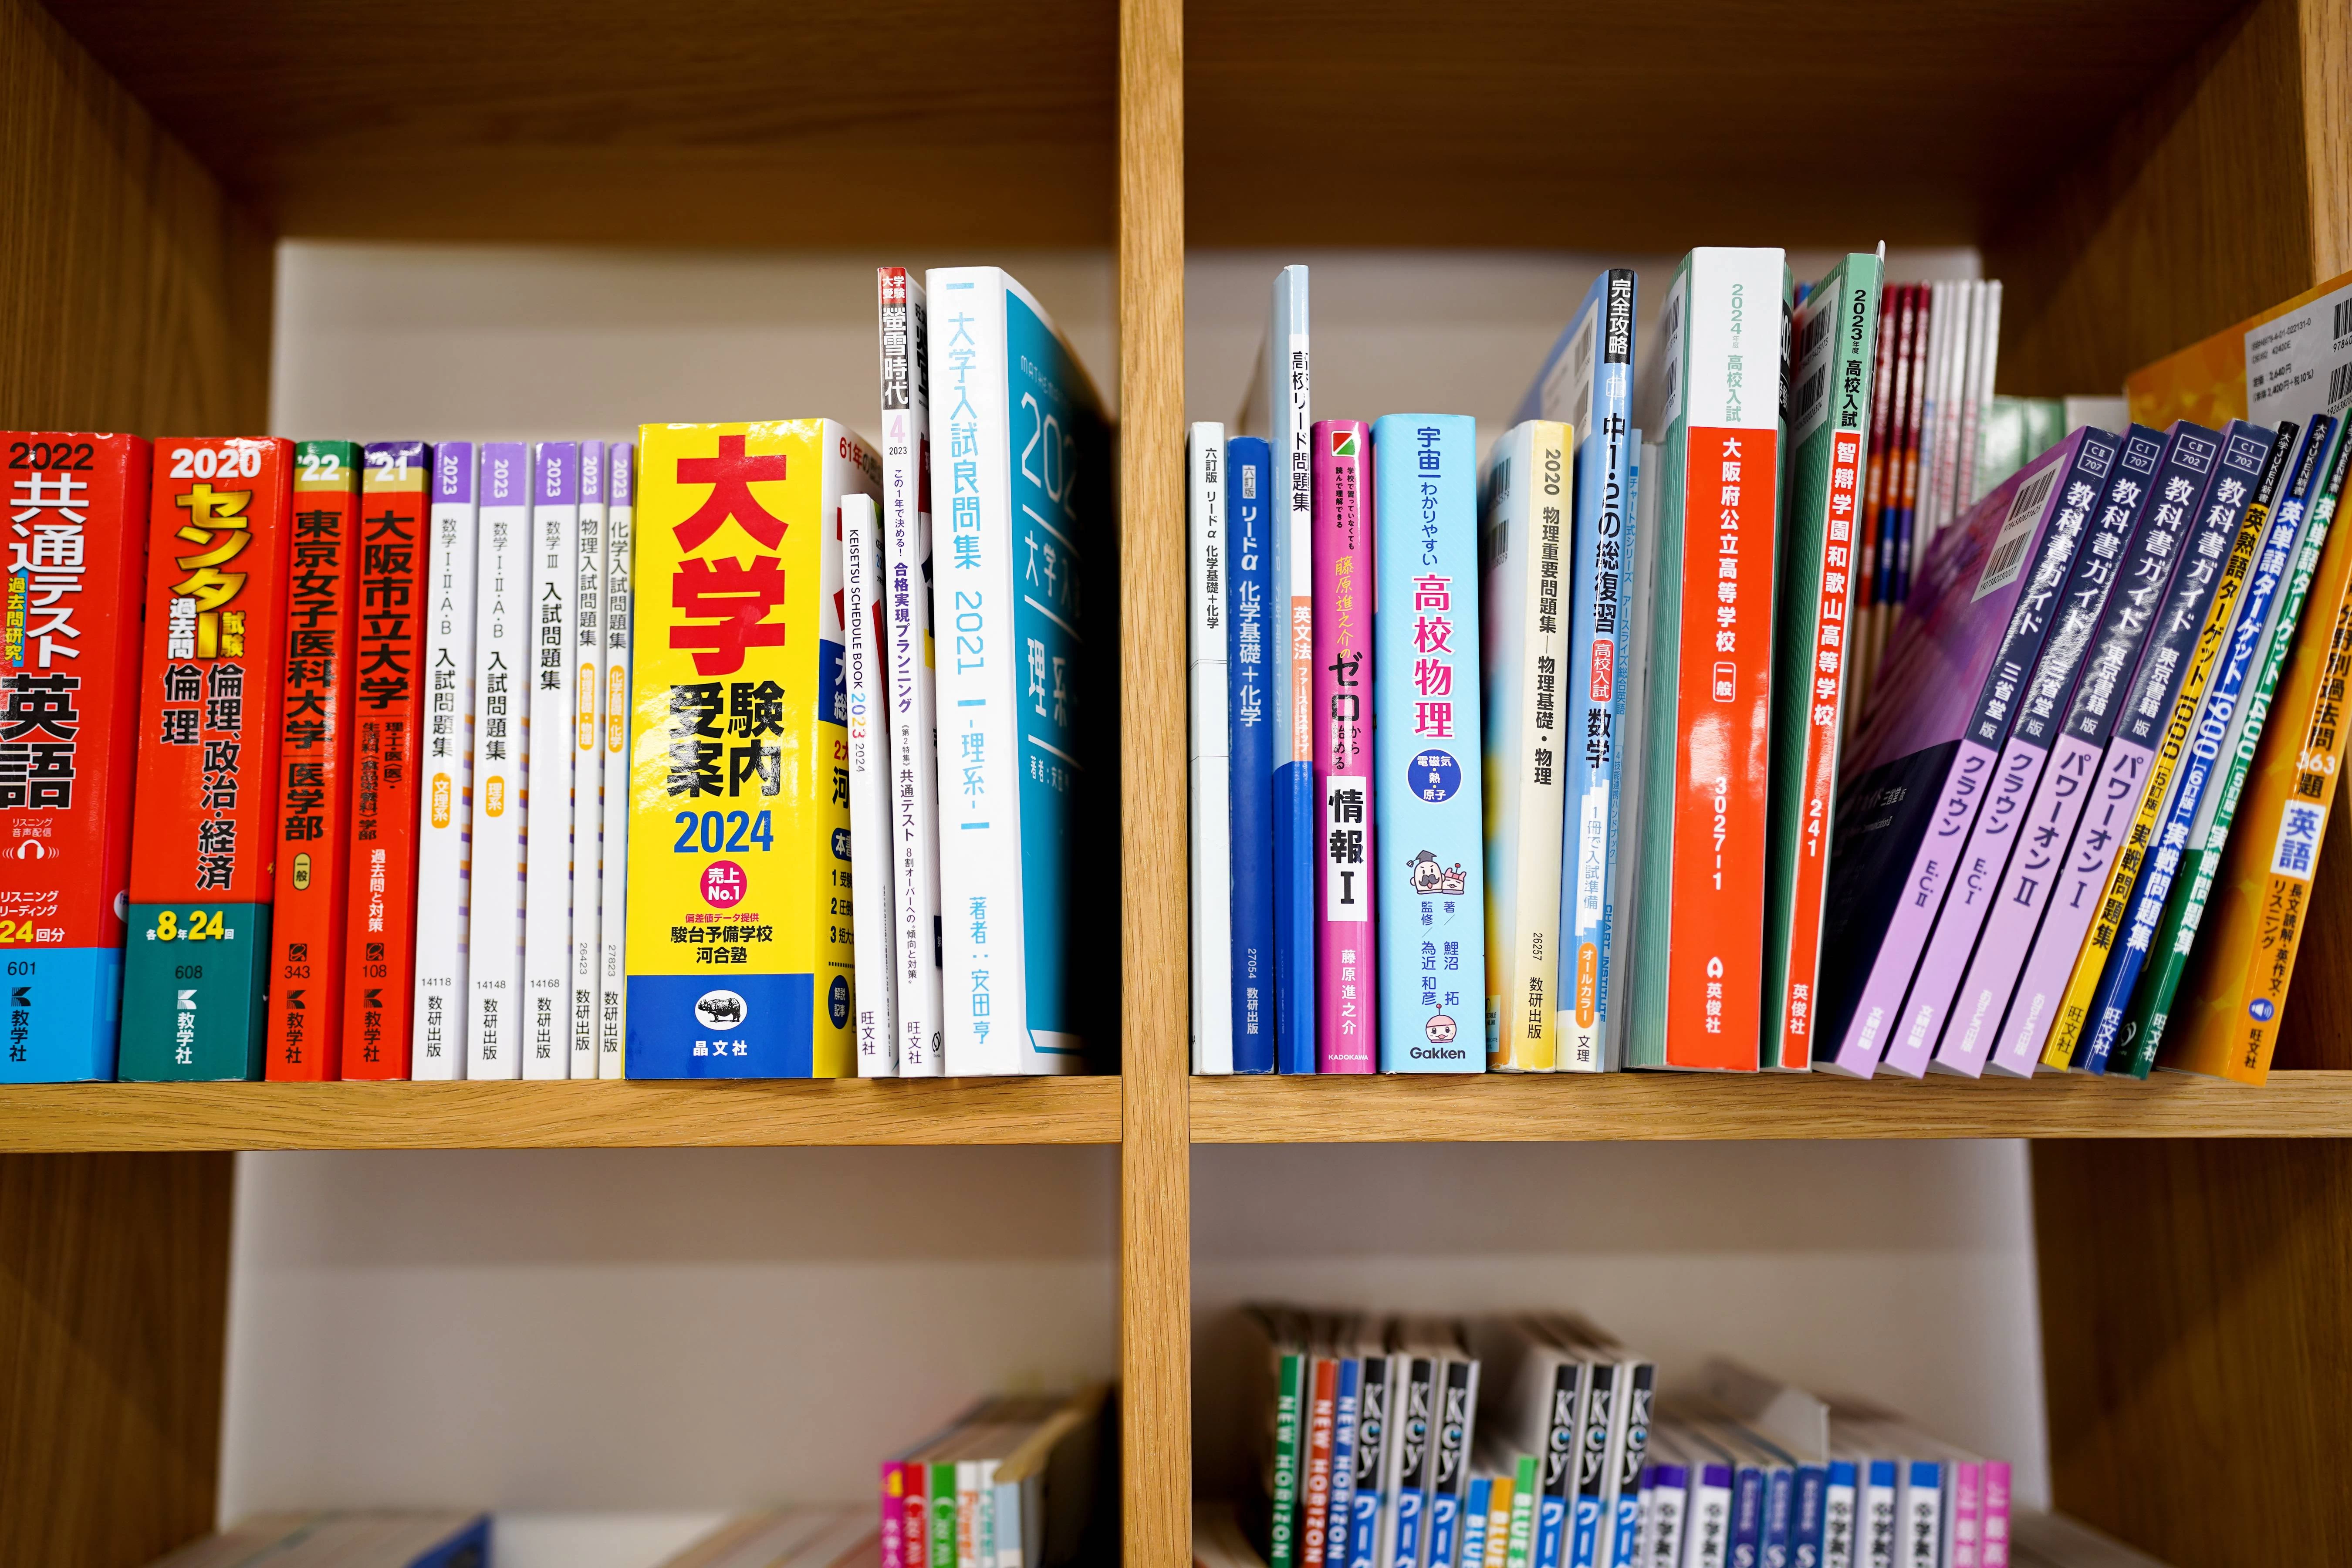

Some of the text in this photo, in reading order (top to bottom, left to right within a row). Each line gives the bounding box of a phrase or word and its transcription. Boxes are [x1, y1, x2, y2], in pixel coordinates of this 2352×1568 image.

[882, 276, 906, 287] 大学
[882, 287, 906, 300] 受験
[1609, 278, 1632, 355] 完全攻略
[1725, 354, 1744, 422] 高校入試
[1841, 359, 1863, 429] 高校入試
[889, 446, 908, 455] 2023
[890, 415, 906, 444] 4
[9, 442, 94, 471] 2022
[170, 449, 261, 479] 2020
[442, 455, 459, 496] 2023
[493, 459, 509, 499] 2023
[546, 457, 562, 498] 2023
[582, 455, 598, 496] 2023
[612, 458, 628, 499] 2023
[1205, 447, 1218, 483] 六訂版
[1243, 466, 1256, 498] 六訂版
[1544, 449, 1561, 496] 2020
[2084, 460, 2103, 472] 707
[2129, 456, 2148, 469] 707
[2182, 454, 2200, 467] 702
[2234, 455, 2253, 468] 702
[948, 311, 984, 675] 大学入試良問集 2021
[1335, 466, 1344, 529] 読んで理解できる
[669, 435, 789, 676] 大学
[1623, 478, 1639, 583] チャート式シリーズ
[1715, 437, 1743, 653] 大阪府公立高等学校
[2064, 477, 2142, 635] 教科書ガイド
[2119, 476, 2196, 632] 教科書ガイド
[2171, 477, 2248, 634] 教科書ガイド
[7, 472, 90, 668] 共通テスト
[169, 483, 253, 659] センター
[579, 519, 599, 647] 物理入試問題集
[1413, 426, 1454, 738] 宇宙一わかりやすい 高校物理
[2019, 480, 2096, 636] 教科書ガイド
[358, 510, 415, 709] 大阪市立大学
[609, 521, 629, 649] 化学入試問題集
[5, 577, 25, 661] 過去問研究
[167, 598, 197, 659] 過去問
[222, 612, 246, 659] 試験
[541, 582, 562, 691] 入試問題集
[893, 562, 912, 714] 合格実現プランニング
[1293, 606, 1312, 660] 英文法
[285, 510, 342, 841] 東京女子医科大学 医学部
[849, 529, 866, 773] KEISETSU SCHEDULE BOOK 2023 2024
[1592, 643, 1612, 699] 高校入試
[1616, 595, 1631, 716] アースライズ総合英語
[160, 664, 204, 746] 倫理
[432, 648, 456, 758] 入試問題集
[486, 652, 507, 761] 入試問題集
[1328, 651, 1363, 722] ゼロ
[1716, 668, 1733, 697] 一般
[0, 672, 81, 809] 英語
[1350, 725, 1362, 755] から
[1416, 755, 1452, 767] 電磁気
[1586, 708, 1612, 769] 数学
[433, 780, 449, 822] 文理系
[488, 782, 502, 811] 理系
[1423, 789, 1446, 801] 原子
[1429, 772, 1441, 784] 熱
[1938, 755, 1986, 837] クラウン
[1985, 753, 2034, 837] クラウン
[12, 818, 53, 827] リスニング
[674, 810, 774, 853] 2024
[900, 769, 916, 842] 共通テスト
[1807, 798, 1823, 857] 241
[12, 828, 52, 838] 音声配信
[2278, 807, 2319, 872] 英語
[0, 890, 59, 903] リスニング
[295, 862, 308, 882] 一般
[368, 849, 386, 933] 過去問と対策
[708, 867, 740, 884] 売上
[708, 886, 740, 901] No.1
[2092, 823, 2151, 951] 実戦問題集
[2126, 822, 2189, 953] 実戦問題集
[2173, 824, 2229, 956] 実戦問題集
[146, 910, 235, 942] 各8年24回
[670, 926, 773, 943] 駿台予備学校
[685, 913, 759, 924] 偏差値データ提供
[1602, 904, 1612, 950] CHART
[2261, 879, 2287, 950] リスニング
[7, 961, 36, 976] 601
[175, 965, 203, 980] 608
[284, 965, 311, 979] 343
[362, 964, 387, 978] 108
[579, 943, 588, 975] 26423
[607, 944, 616, 977] 27823
[696, 947, 747, 964] 河合塾
[421, 977, 451, 987] 14118
[477, 980, 507, 990] 14148
[531, 979, 560, 988] 14168
[1246, 948, 1259, 1035] 27054 数研出版
[1341, 949, 1358, 1036] 藤原進之介
[1527, 932, 1544, 1040] 26257 数研出版
[1581, 949, 1594, 1021] オールカラー
[1705, 982, 1723, 1034] 英俊社
[426, 995, 443, 1058] 数研出版
[483, 998, 498, 1061] 数研出版
[536, 997, 552, 1059] 数研出版
[575, 989, 591, 1051] 数研出版
[603, 991, 619, 1053] 数研出版
[861, 1011, 876, 1056] 旺文社
[1790, 983, 1809, 1035] 英俊社
[2056, 1005, 2085, 1055] 旺文社
[2094, 1006, 2122, 1057] 旺文社
[10, 1010, 29, 1062] 教学社
[175, 1012, 195, 1064] 教学社
[285, 1012, 304, 1064] 教学社
[363, 1011, 382, 1063] 教学社
[693, 1041, 748, 1056] 晶文社
[908, 1021, 923, 1065] 旺文社
[1410, 1047, 1466, 1059] Gakken
[1576, 1034, 1591, 1062] 文理
[2142, 1013, 2168, 1063] 旺文社
[2244, 1027, 2264, 1070] 旺文社
[1271, 1395, 1297, 1559] NEW HORIZON
[1304, 1399, 1333, 1564] NEW HORIZON
[1327, 1396, 1357, 1561] NEW HORIZON
